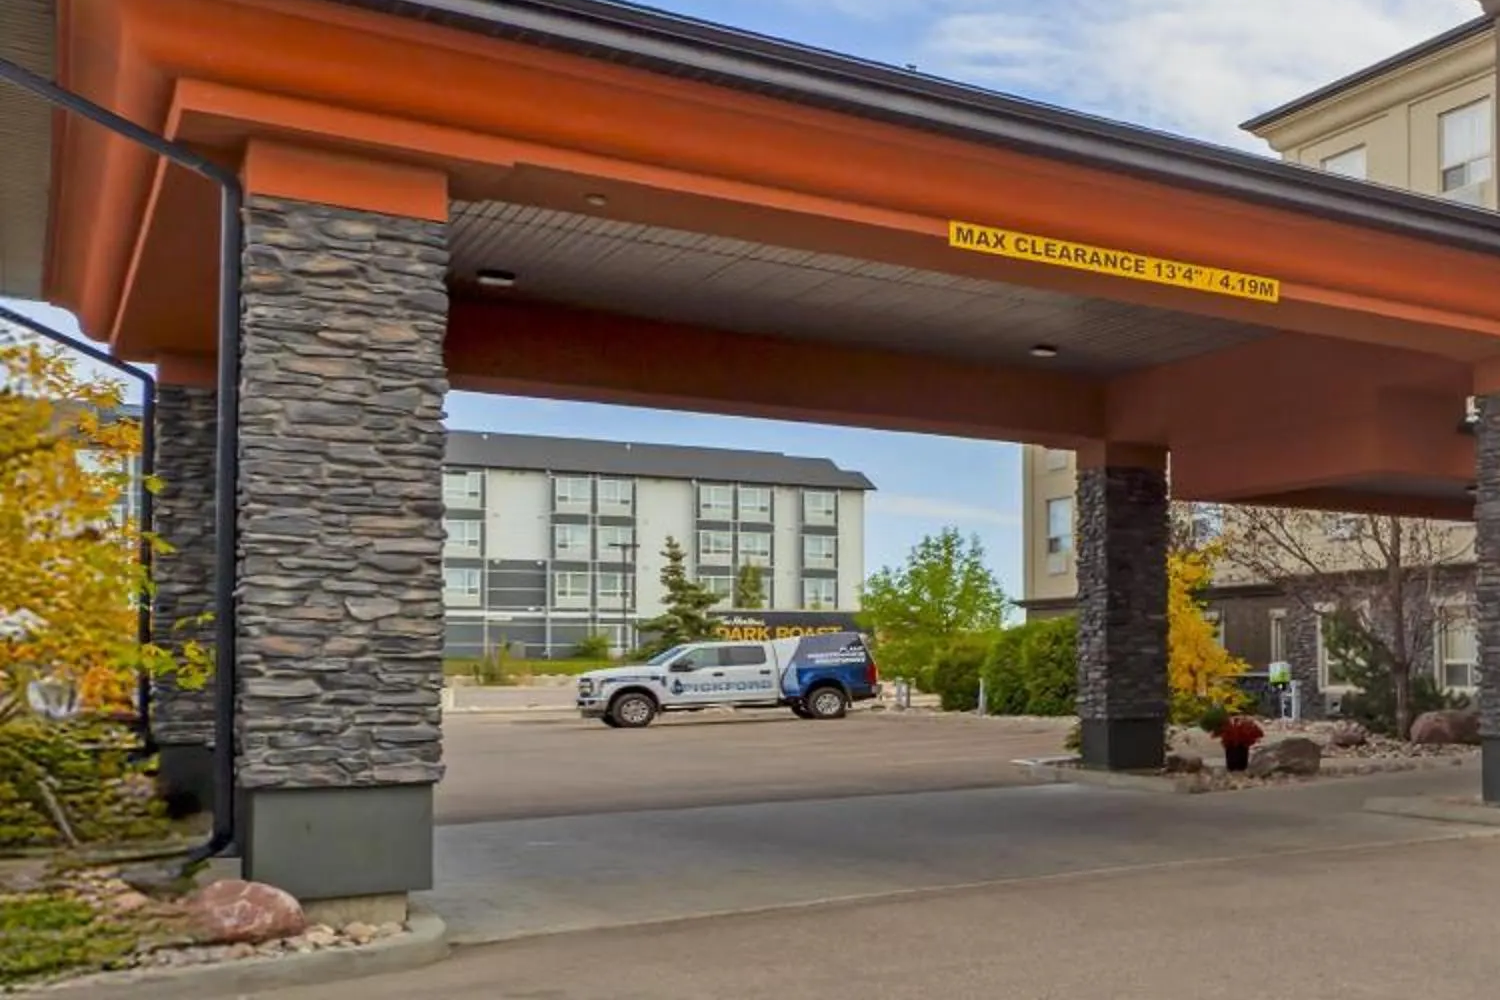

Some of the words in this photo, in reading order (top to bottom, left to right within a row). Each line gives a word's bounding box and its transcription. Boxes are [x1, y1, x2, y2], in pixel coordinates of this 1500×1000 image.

[955, 226, 1006, 249] MAX
[1014, 237, 1146, 274] CLEARANCE
[1219, 274, 1275, 297] 4.19M
[717, 625, 769, 640] DARK
